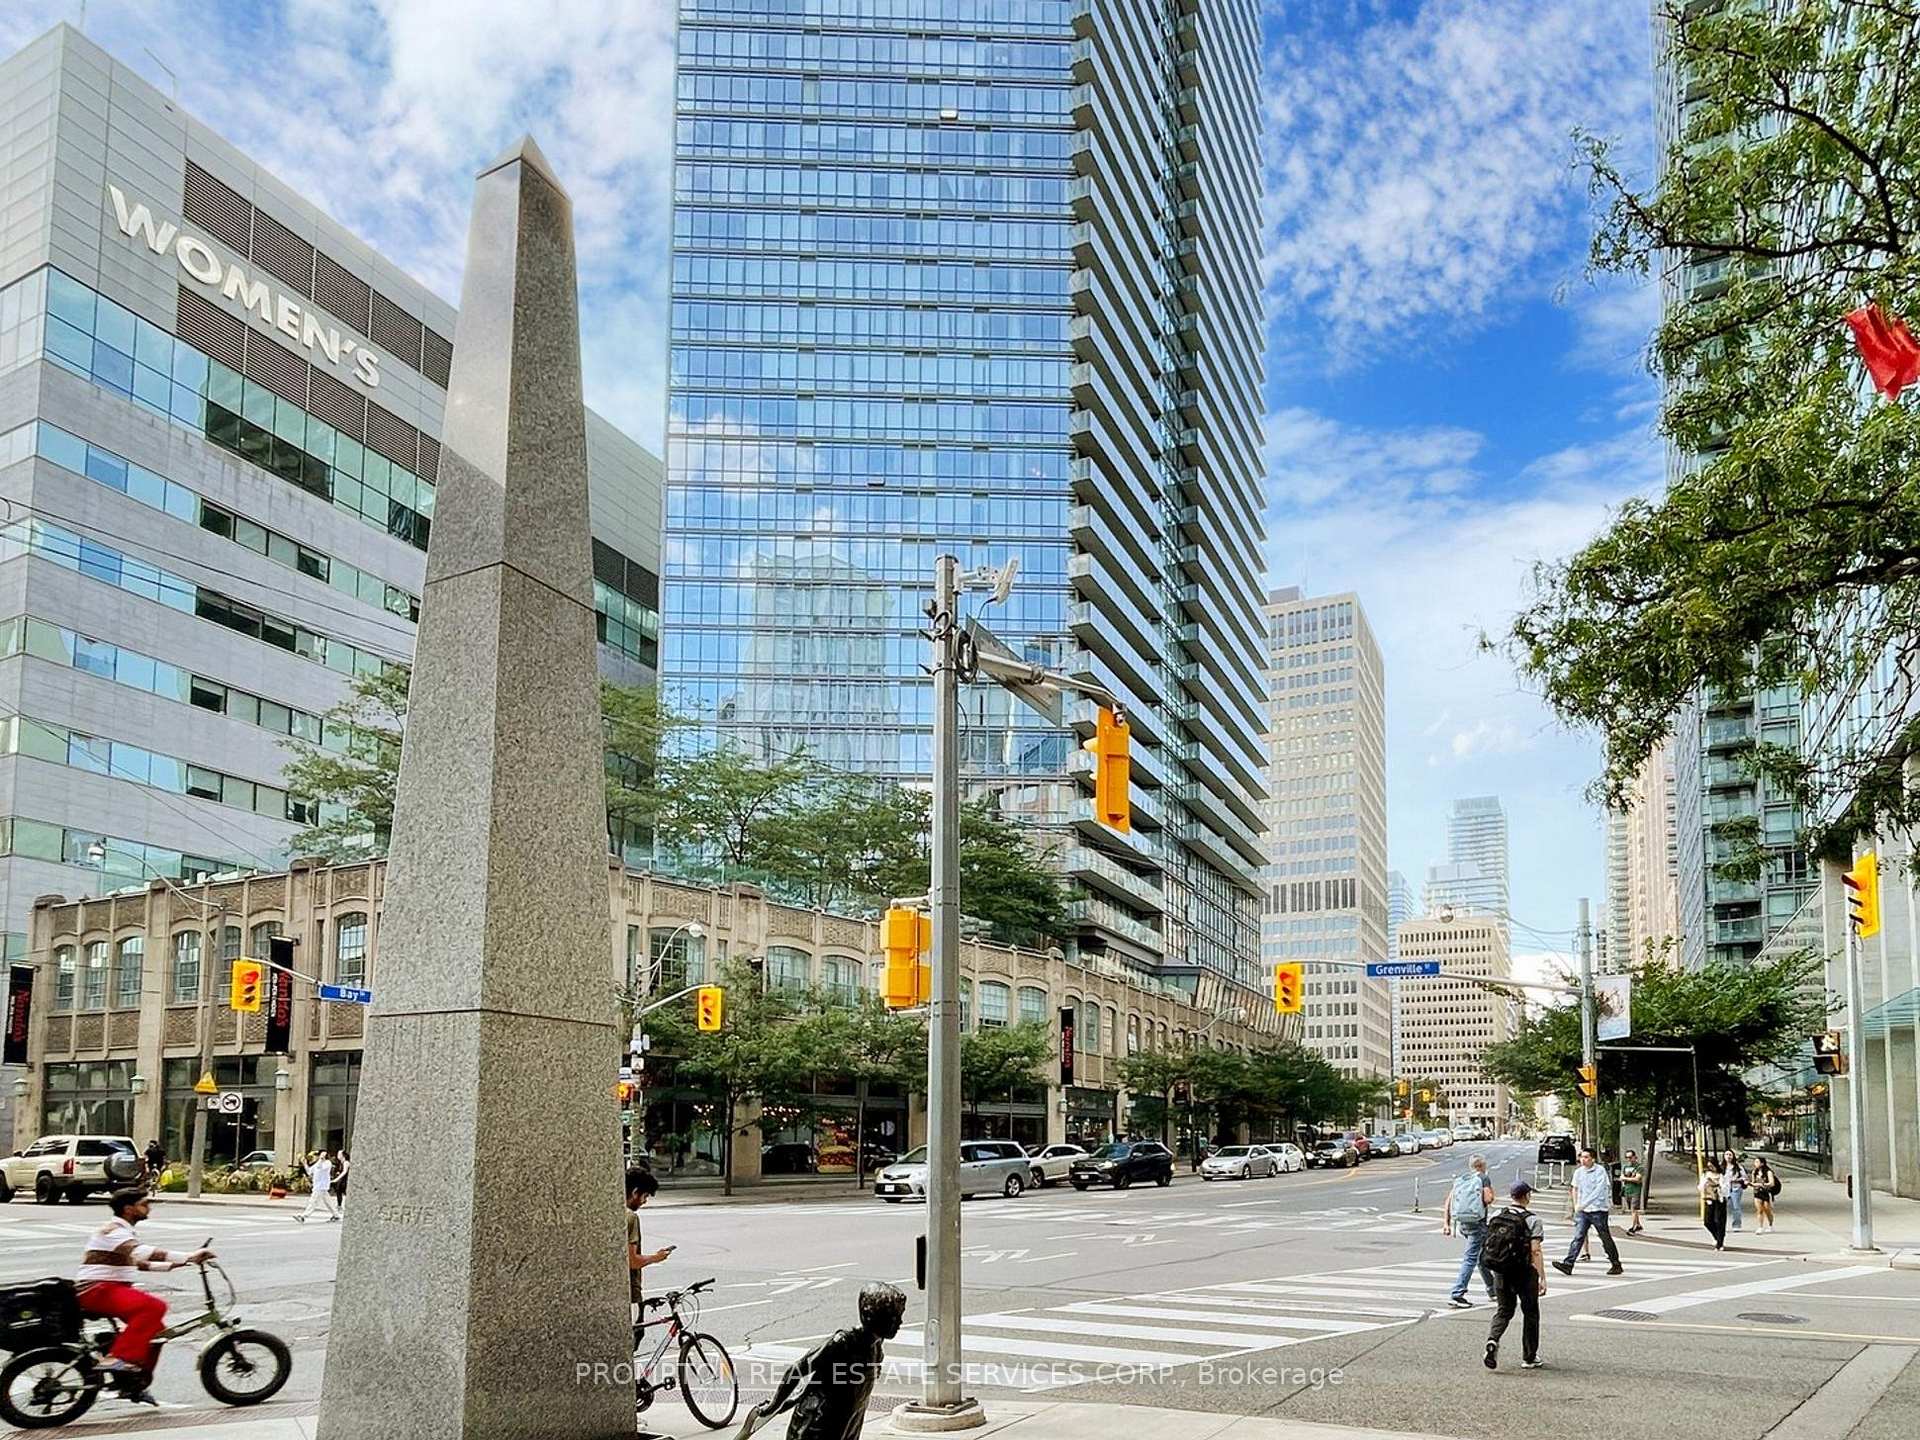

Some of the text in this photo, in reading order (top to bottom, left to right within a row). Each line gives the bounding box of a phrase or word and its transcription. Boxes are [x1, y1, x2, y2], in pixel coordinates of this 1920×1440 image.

[107, 182, 381, 388] WOMEN'S
[1375, 963, 1423, 975] Grenville
[340, 988, 359, 1001] Bay
